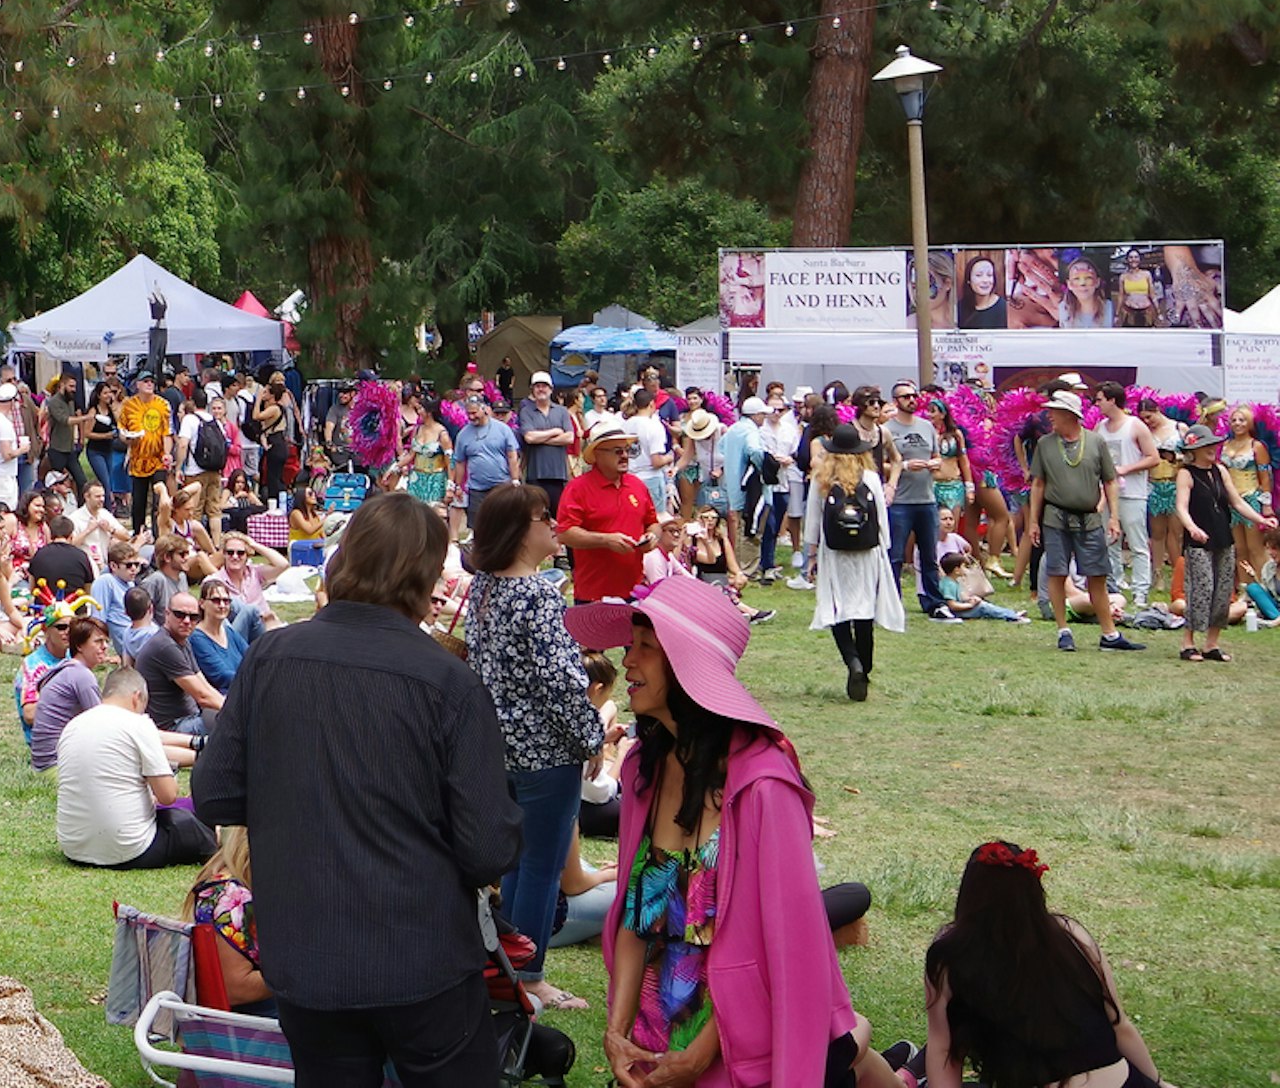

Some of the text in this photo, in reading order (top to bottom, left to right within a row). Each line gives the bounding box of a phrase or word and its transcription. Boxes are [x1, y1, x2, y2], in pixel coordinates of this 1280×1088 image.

[803, 256, 866, 267] Santa Barbara
[769, 271, 901, 285] FACE PAINTING
[783, 294, 887, 308] AND HENNA
[678, 336, 719, 346] HENNA
[947, 344, 993, 353] PAINTING
